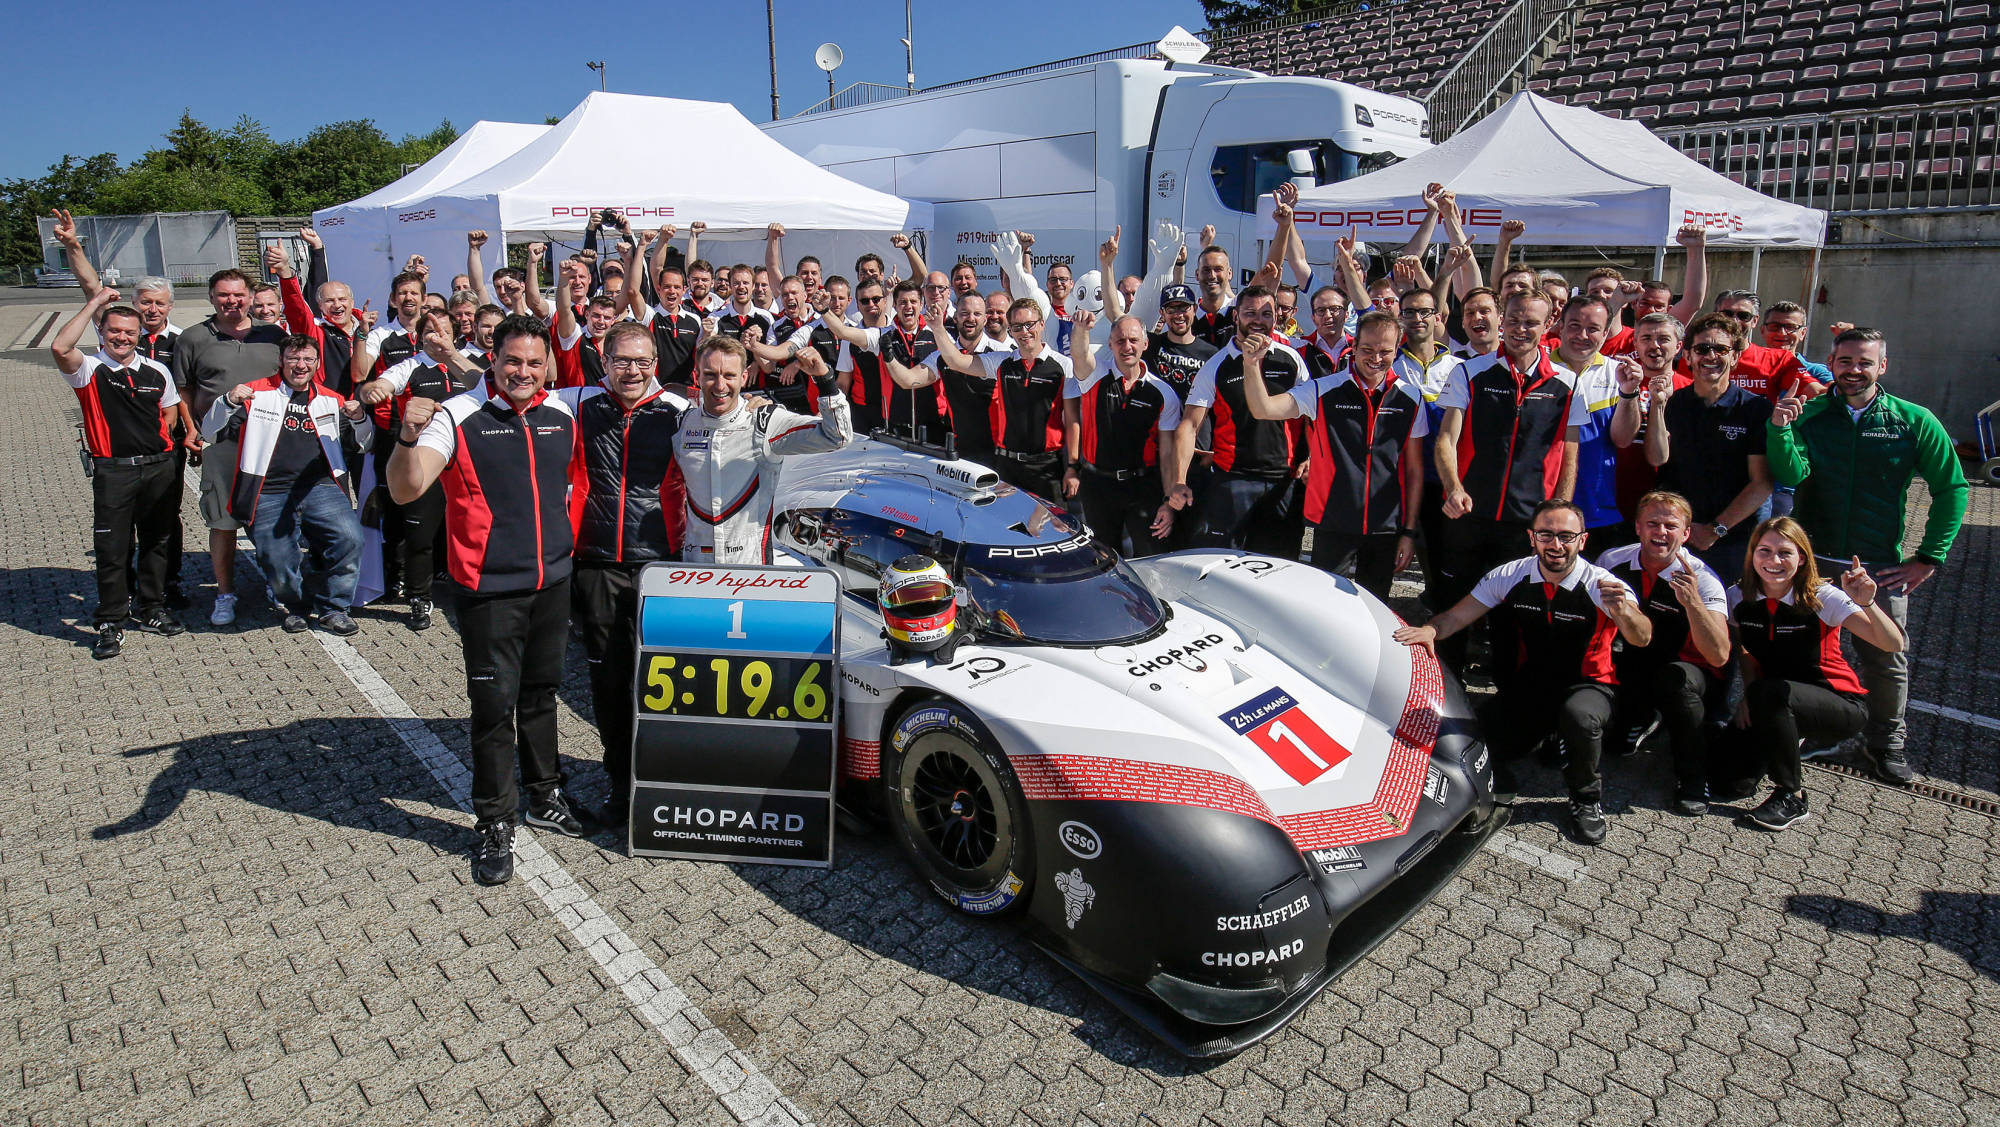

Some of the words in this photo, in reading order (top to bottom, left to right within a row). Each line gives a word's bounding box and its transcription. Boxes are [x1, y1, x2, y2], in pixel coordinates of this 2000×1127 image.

[1373, 109, 1418, 125] PORSCHE
[320, 217, 345, 227] PORSCHE
[399, 209, 436, 224] PORSCHE
[1683, 209, 1743, 231] PORSCHE
[957, 254, 993, 267] Mission:
[1029, 253, 1075, 268] Sportscar
[1227, 375, 1245, 384] CHOPA
[1731, 379, 1767, 389] RIBUTE
[686, 429, 702, 438] Mobil
[1861, 431, 1900, 439] SCHAEFFLER
[936, 463, 961, 480] Mobil
[960, 471, 971, 484] 1
[725, 545, 744, 554] Timo
[988, 523, 1094, 558] PORSCHE
[668, 570, 715, 585] 919
[715, 571, 812, 596] hybrid
[726, 600, 747, 640] 1
[910, 631, 946, 642] CHOPARD
[1128, 634, 1224, 677] CHOPARD
[643, 656, 827, 720] 5:19.6
[841, 671, 880, 697] HOPARD
[1251, 708, 1266, 720] LE
[1262, 695, 1290, 712] MANS
[905, 711, 946, 732] MICHELIN
[1267, 720, 1330, 771] 1
[1423, 773, 1440, 800] Mobil
[653, 805, 804, 832] CHOPARD
[653, 830, 704, 841] OFFICIAL
[704, 833, 746, 844] TIMING
[747, 836, 804, 848] PARTNER
[1311, 846, 1350, 864] Mobil
[1345, 846, 1362, 859] 1
[1334, 862, 1363, 870] MICHELIN
[962, 893, 1006, 912] MICHELIN
[1217, 895, 1311, 931] SCHAEFFLER
[1201, 938, 1304, 967] CHOPARD
